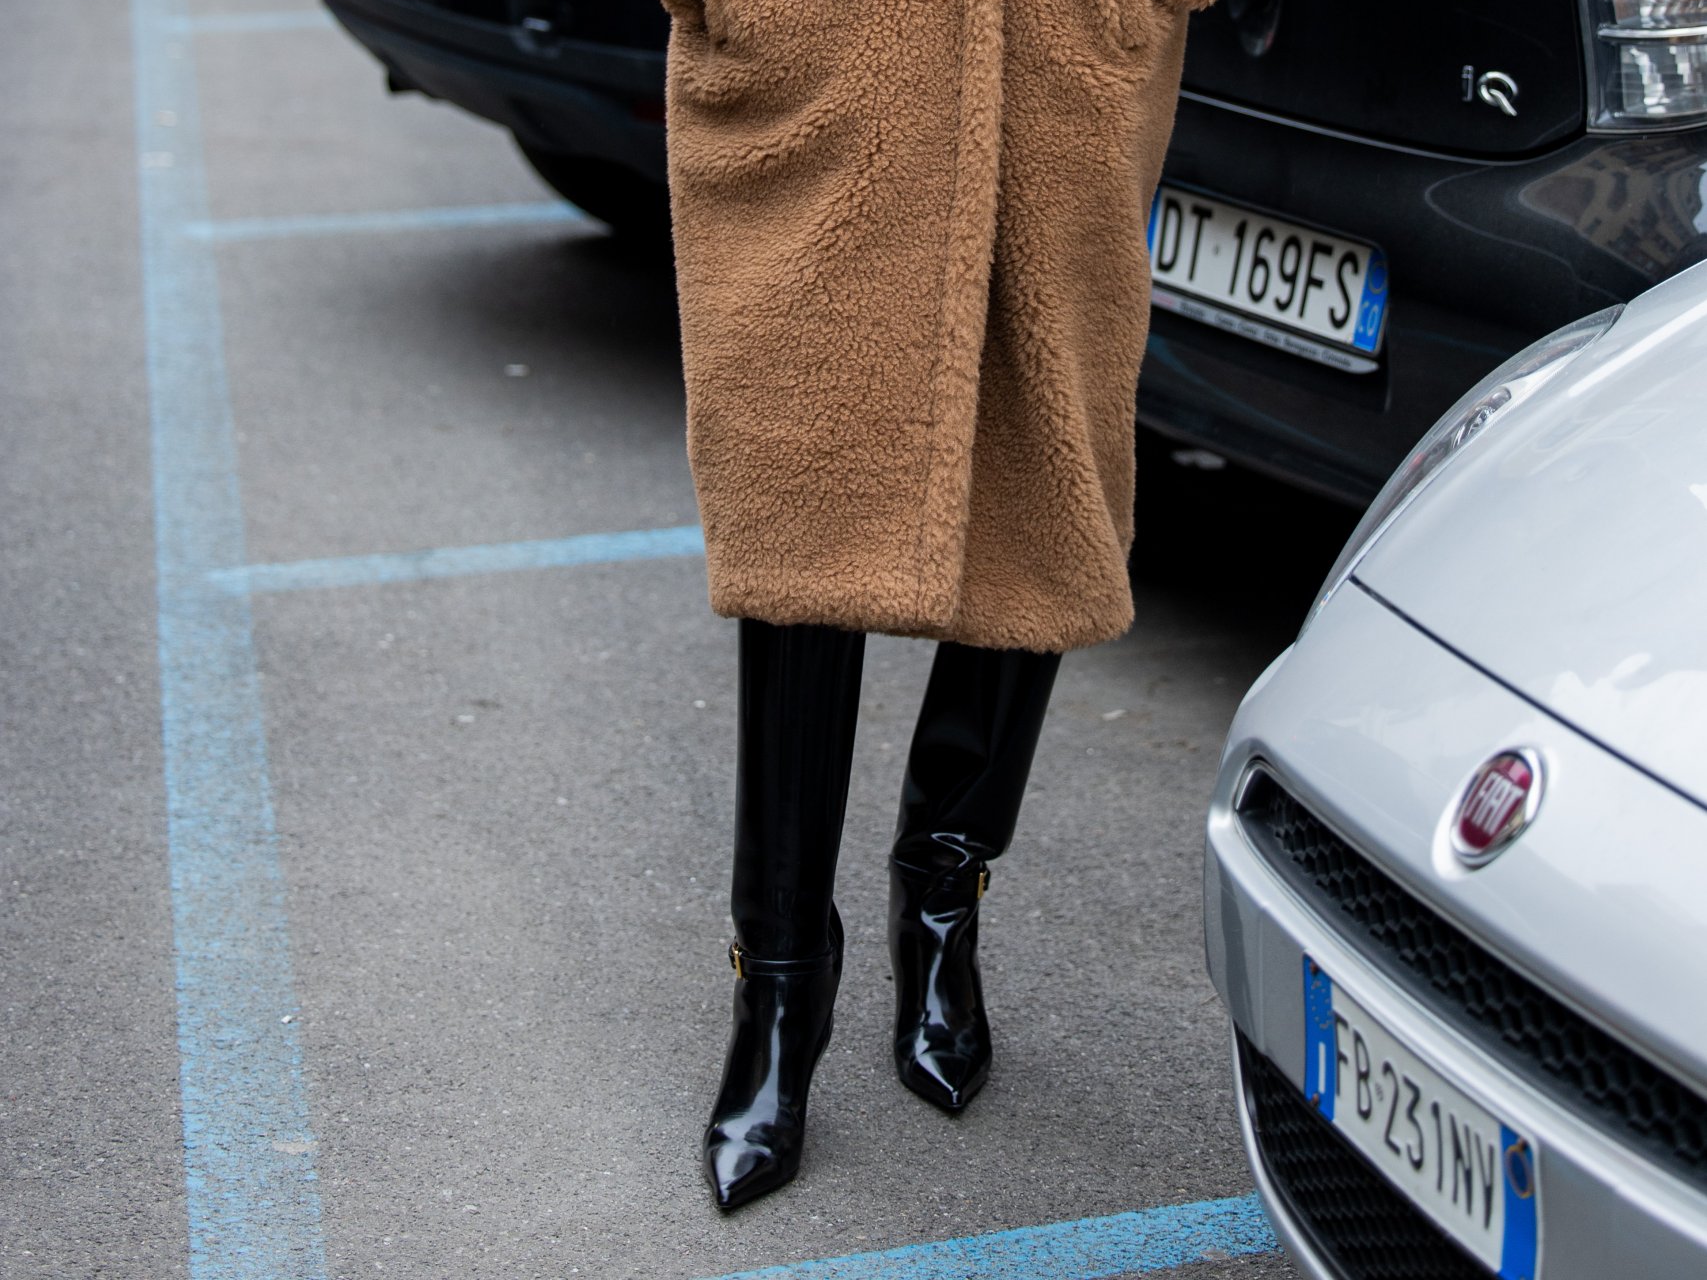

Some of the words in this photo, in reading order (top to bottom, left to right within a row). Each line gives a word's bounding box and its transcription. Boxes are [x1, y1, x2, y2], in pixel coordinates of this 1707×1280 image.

[1156, 197, 1212, 281] DT
[1227, 219, 1359, 330] 169FS
[1465, 771, 1525, 836] FIAT
[1332, 1010, 1372, 1122] FB
[1382, 1059, 1494, 1231] 231NV
